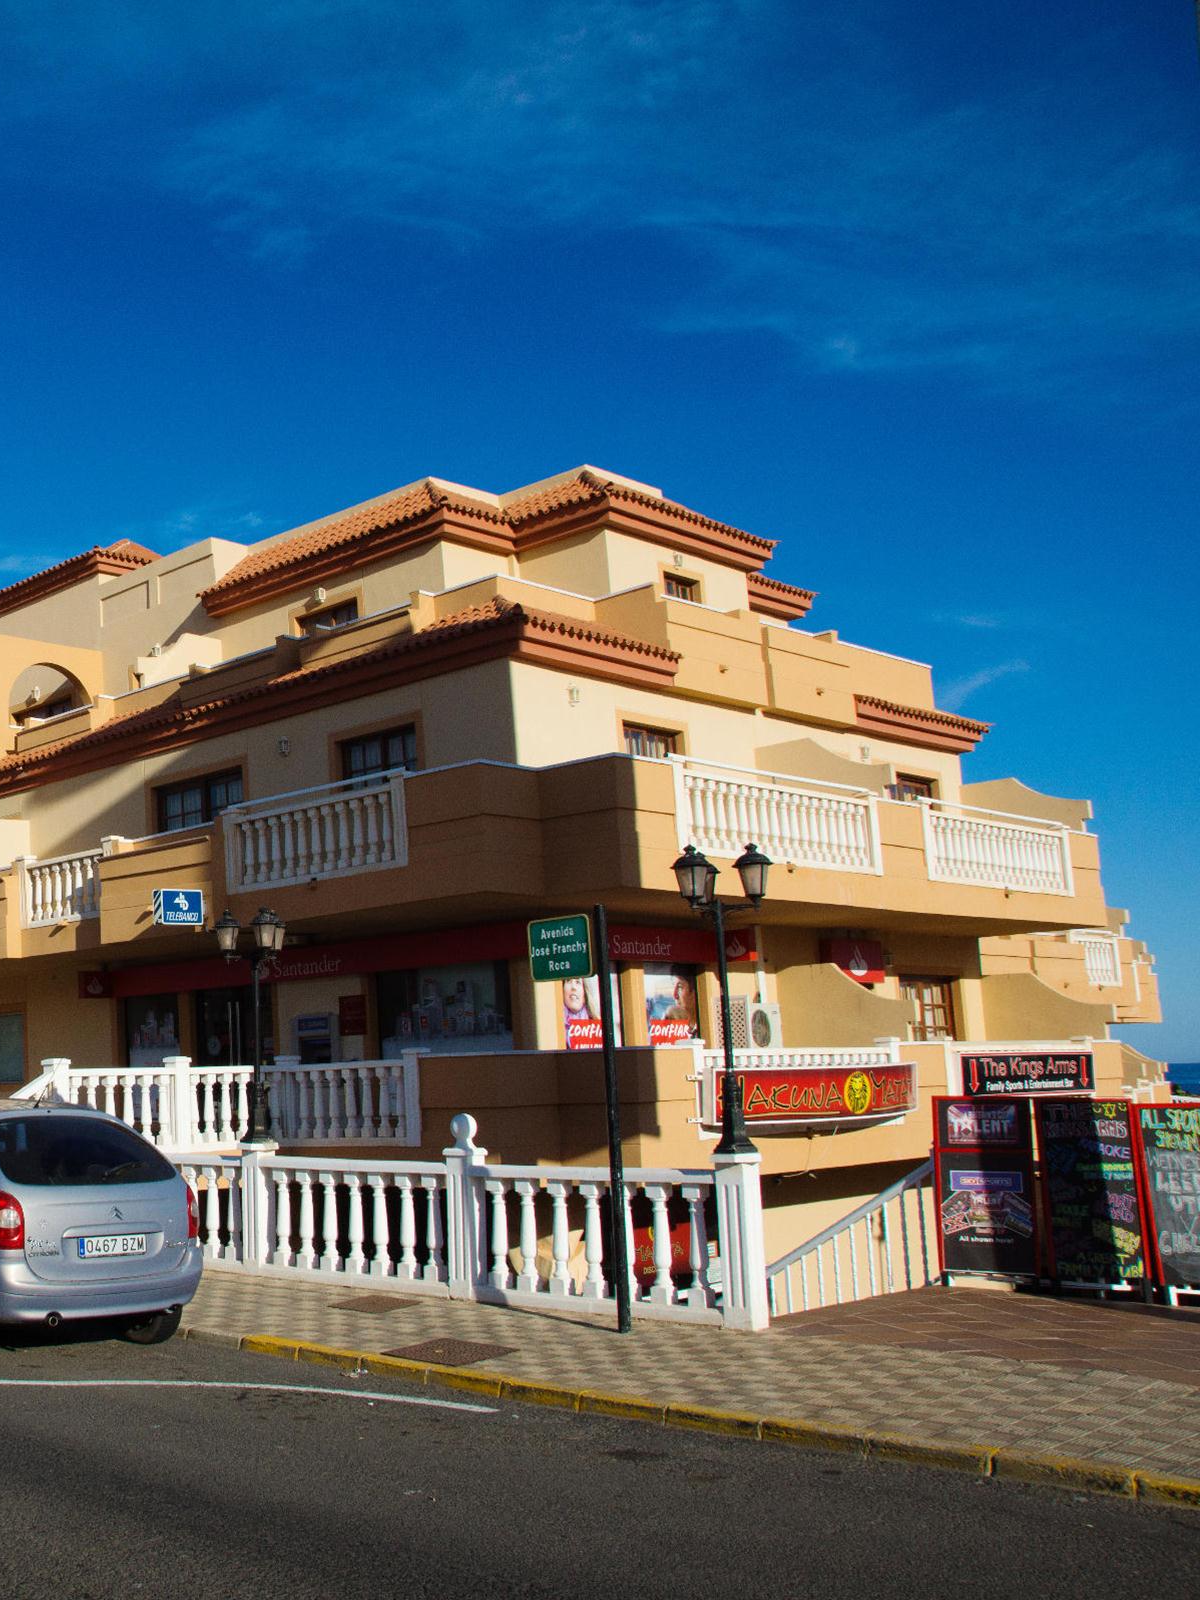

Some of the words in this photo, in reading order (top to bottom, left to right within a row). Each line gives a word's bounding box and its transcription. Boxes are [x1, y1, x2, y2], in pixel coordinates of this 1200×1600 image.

[166, 911, 199, 922] TELEBANCO
[540, 926, 575, 940] Avenida
[531, 945, 550, 958] José
[552, 940, 587, 955] Franchy
[612, 934, 672, 956] Santander
[273, 954, 342, 978] Santander
[549, 960, 571, 972] Roca
[980, 1058, 1007, 1077] The
[1009, 1057, 1045, 1079] Kings
[1046, 1057, 1078, 1075] Arms
[986, 1081, 1005, 1092] Family
[1005, 1080, 1023, 1092] Sports
[86, 1238, 118, 1252] 0467
[122, 1236, 145, 1251] BZM
